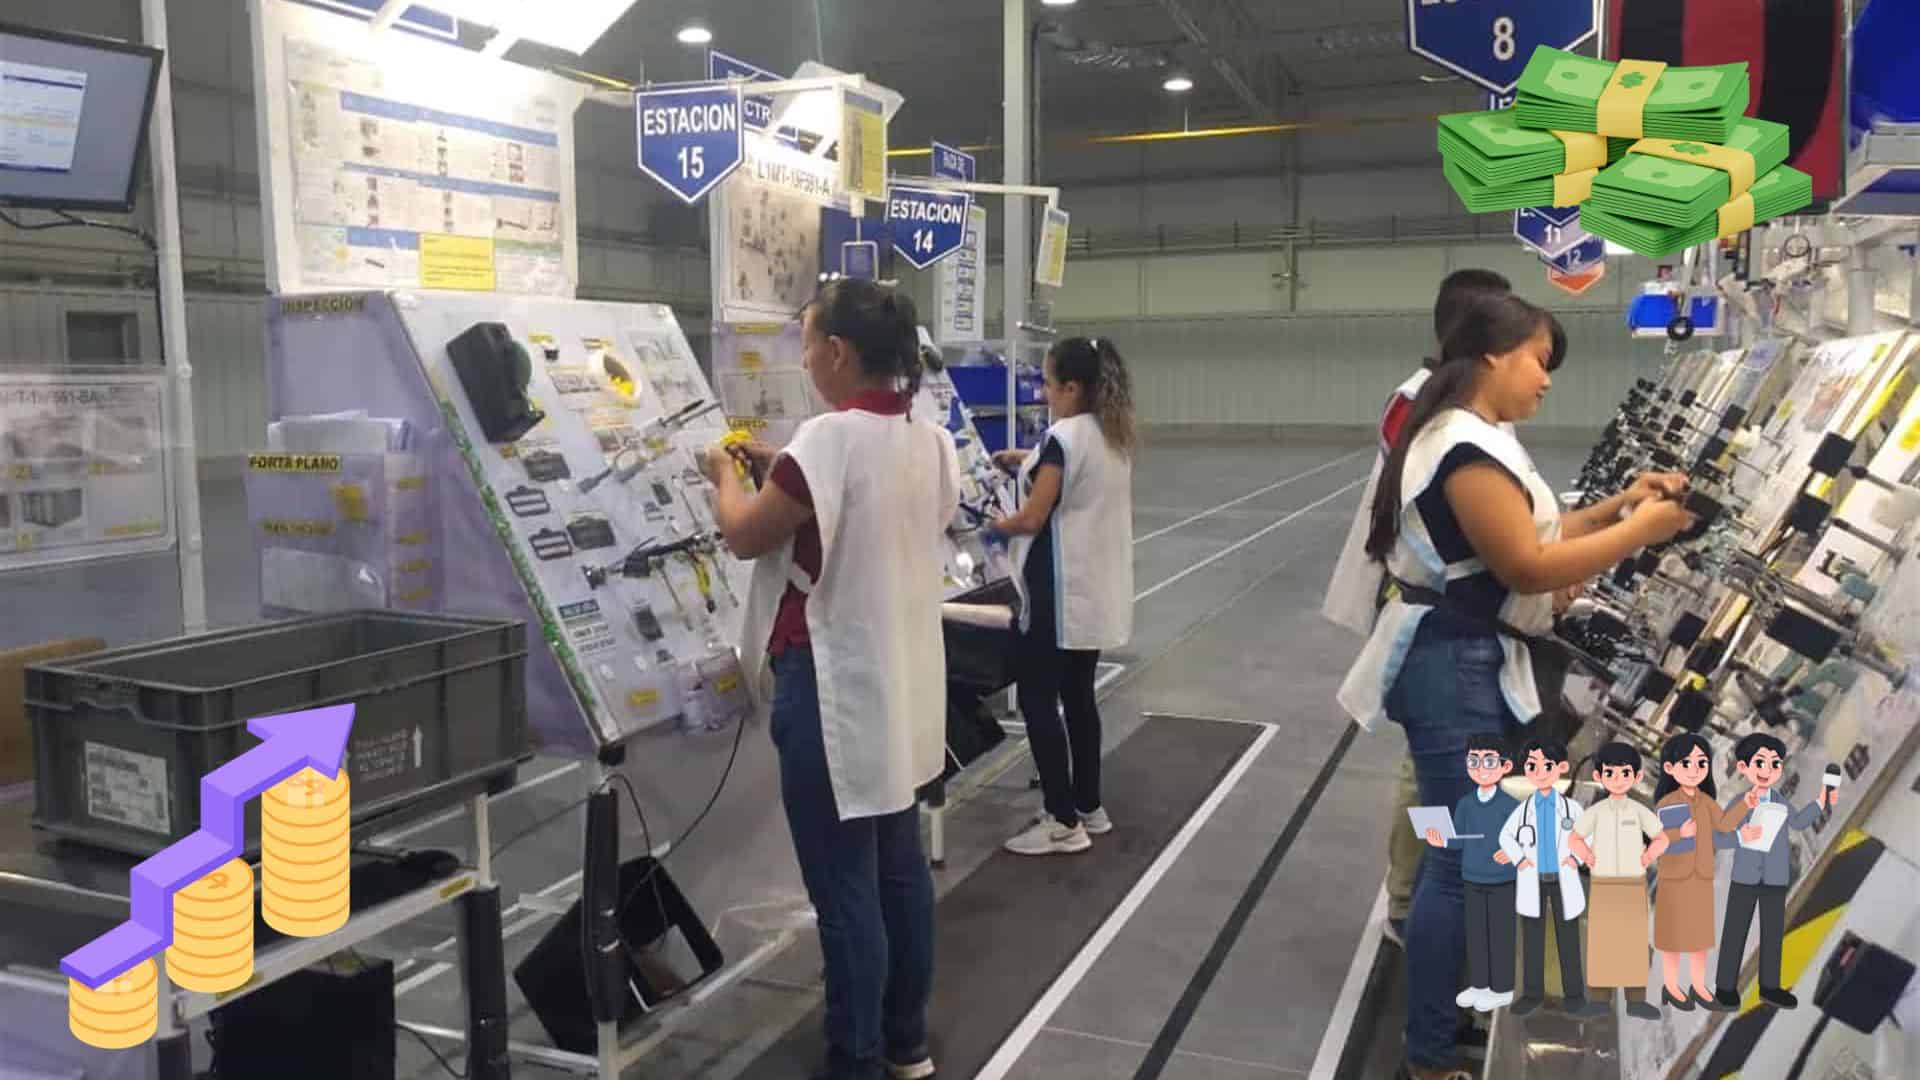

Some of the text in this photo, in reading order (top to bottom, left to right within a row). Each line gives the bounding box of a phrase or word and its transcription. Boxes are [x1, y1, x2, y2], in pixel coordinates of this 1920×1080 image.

[1493, 16, 1516, 60] 8
[643, 104, 736, 136] ESTACION
[677, 147, 705, 179] 15
[891, 200, 961, 223] ESTACION
[913, 230, 933, 253] 14
[1544, 223, 1561, 243] 11
[1566, 249, 1581, 265] 12
[249, 456, 338, 471] PORTA PLANO
